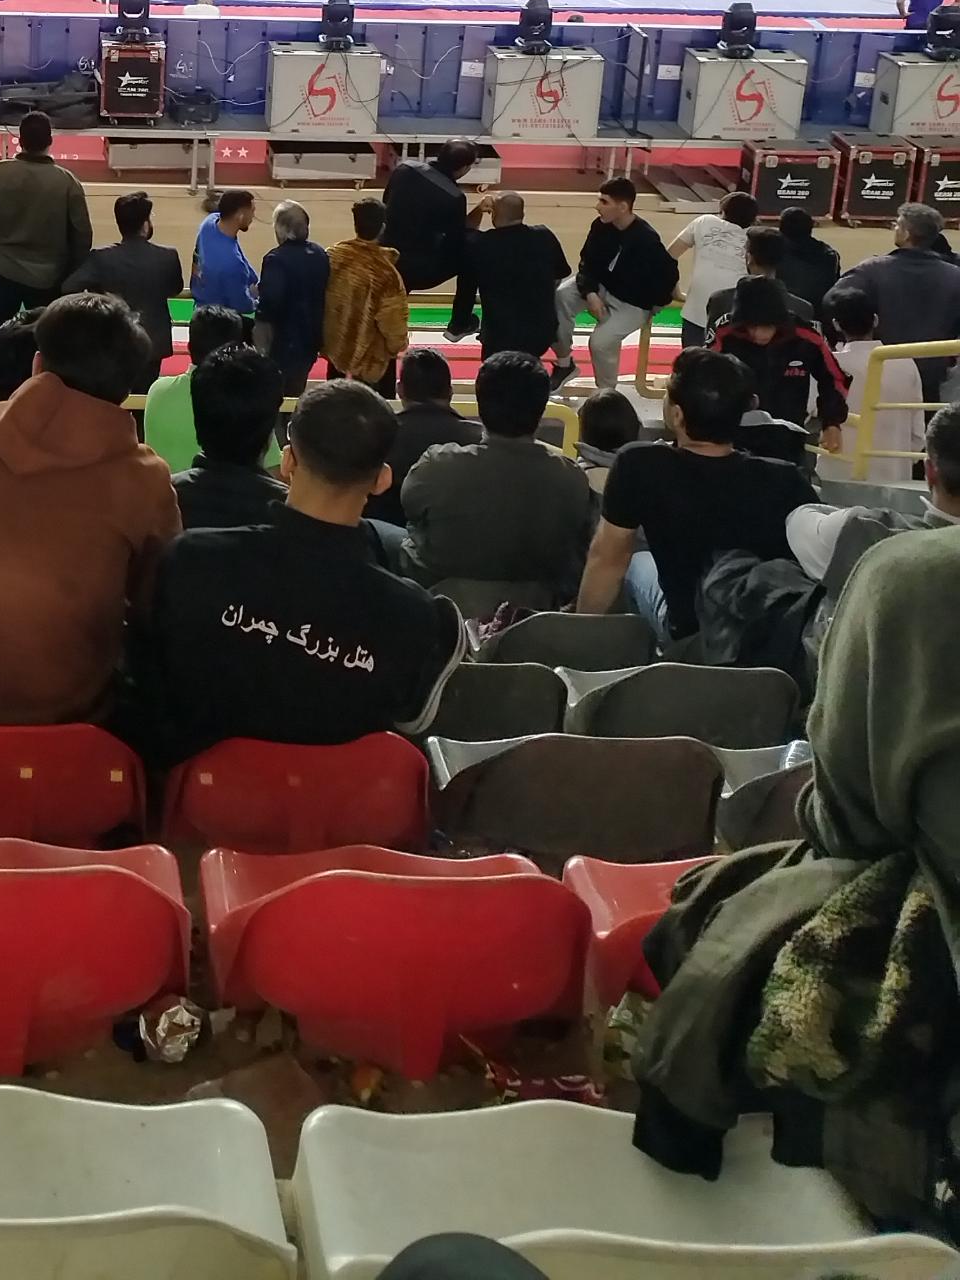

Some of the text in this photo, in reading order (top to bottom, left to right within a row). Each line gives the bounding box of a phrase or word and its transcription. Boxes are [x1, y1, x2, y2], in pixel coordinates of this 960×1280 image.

[221, 604, 375, 673] هتل بزرگ چمران
